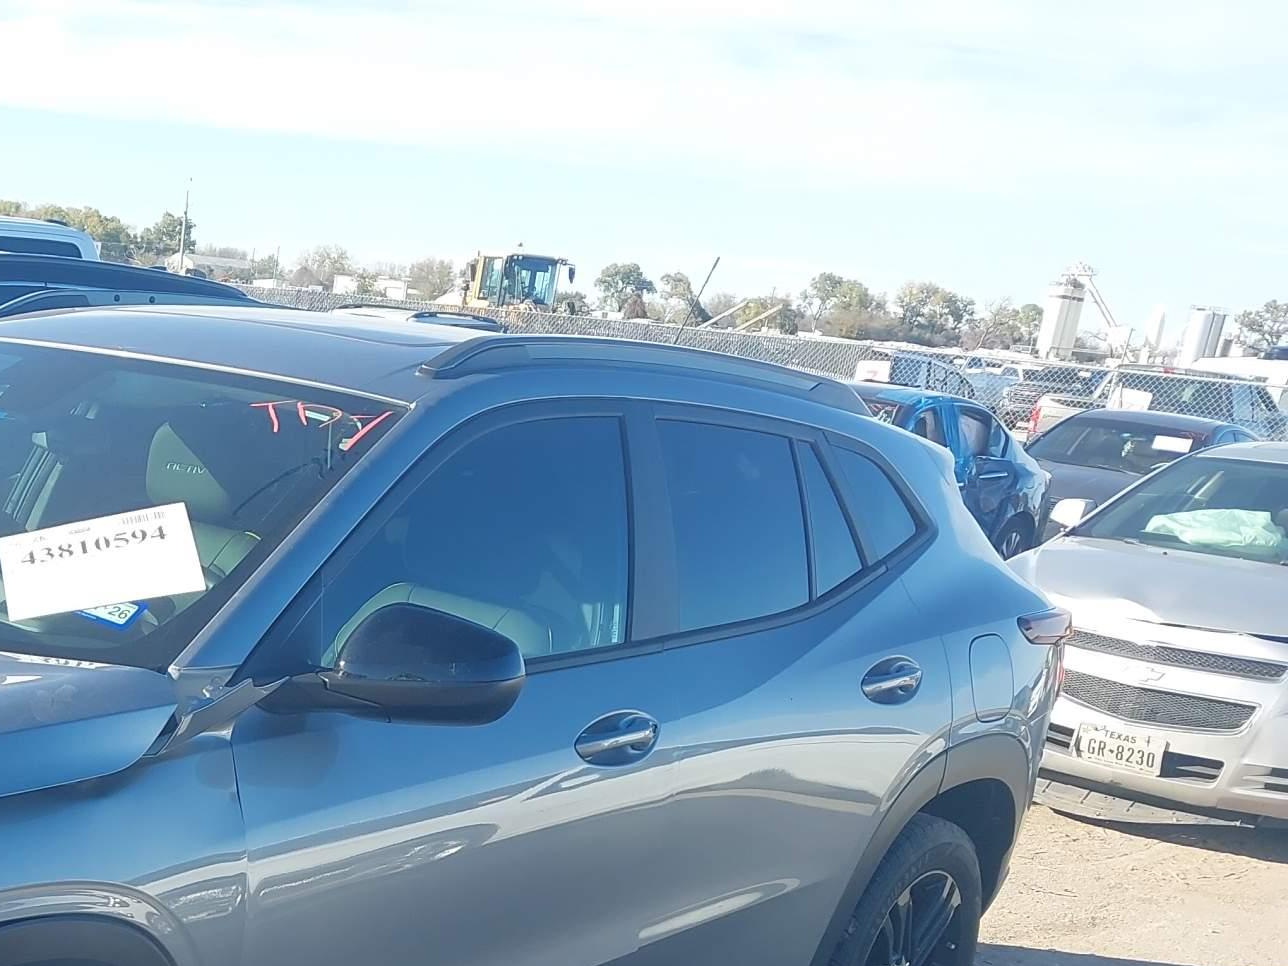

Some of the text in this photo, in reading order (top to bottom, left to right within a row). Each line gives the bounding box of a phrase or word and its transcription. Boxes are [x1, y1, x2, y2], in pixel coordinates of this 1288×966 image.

[21, 525, 168, 565] 43810594
[107, 606, 131, 620] 26
[1104, 729, 1137, 744] TEXAS
